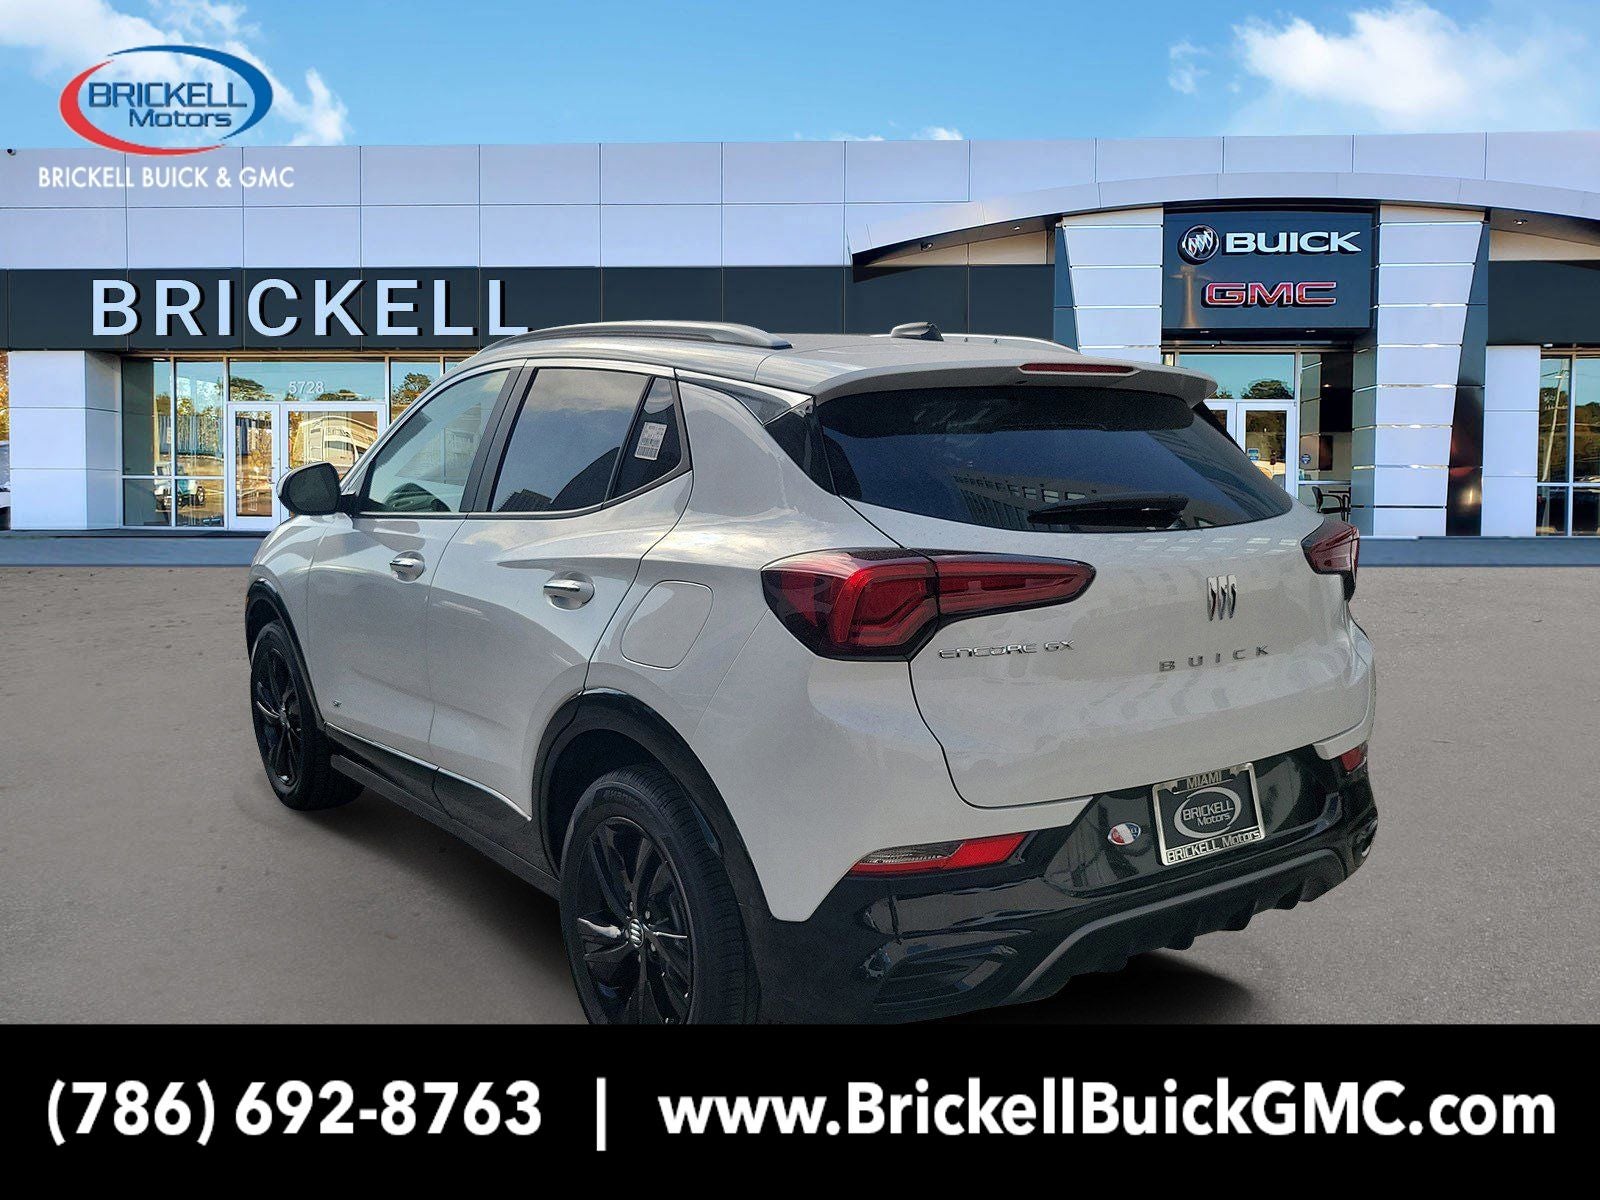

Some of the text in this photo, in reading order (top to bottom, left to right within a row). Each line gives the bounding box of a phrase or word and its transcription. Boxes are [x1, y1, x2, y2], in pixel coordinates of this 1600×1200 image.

[1225, 231, 1362, 253] BUICK
[1204, 281, 1337, 306] GMC
[92, 278, 532, 337] BRICKELL
[288, 380, 325, 394] 5728
[938, 640, 1076, 660] ENCORE GX
[1158, 644, 1272, 672] BUICK
[1186, 770, 1223, 789] MIAMI
[1182, 799, 1234, 822] BRICKELL
[1197, 812, 1231, 827] Motors
[1166, 829, 1261, 864] BRICKELL Motors
